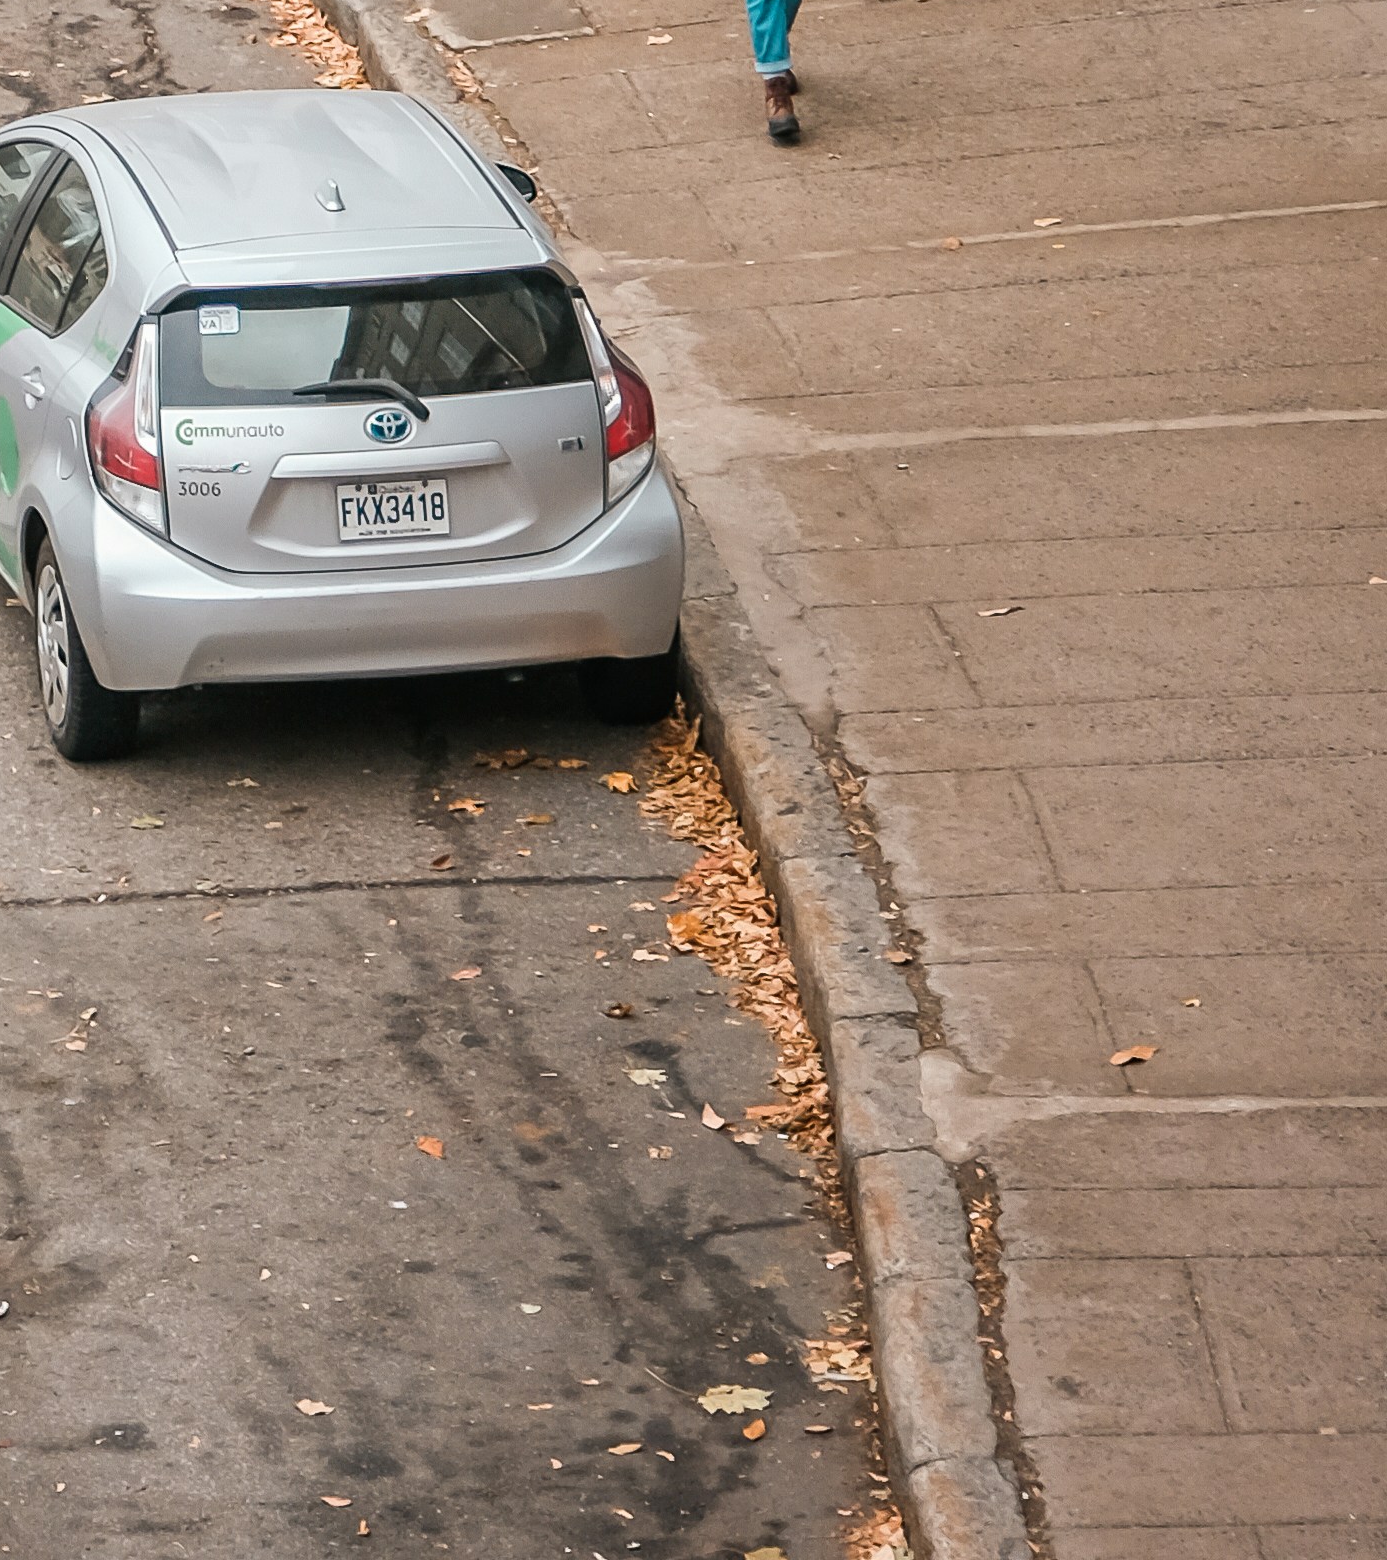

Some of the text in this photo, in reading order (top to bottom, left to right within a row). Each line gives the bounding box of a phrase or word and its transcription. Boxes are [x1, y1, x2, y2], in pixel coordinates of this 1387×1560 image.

[175, 418, 285, 446] Communauto
[178, 481, 222, 497] 3006
[340, 491, 445, 528] FKX3418
